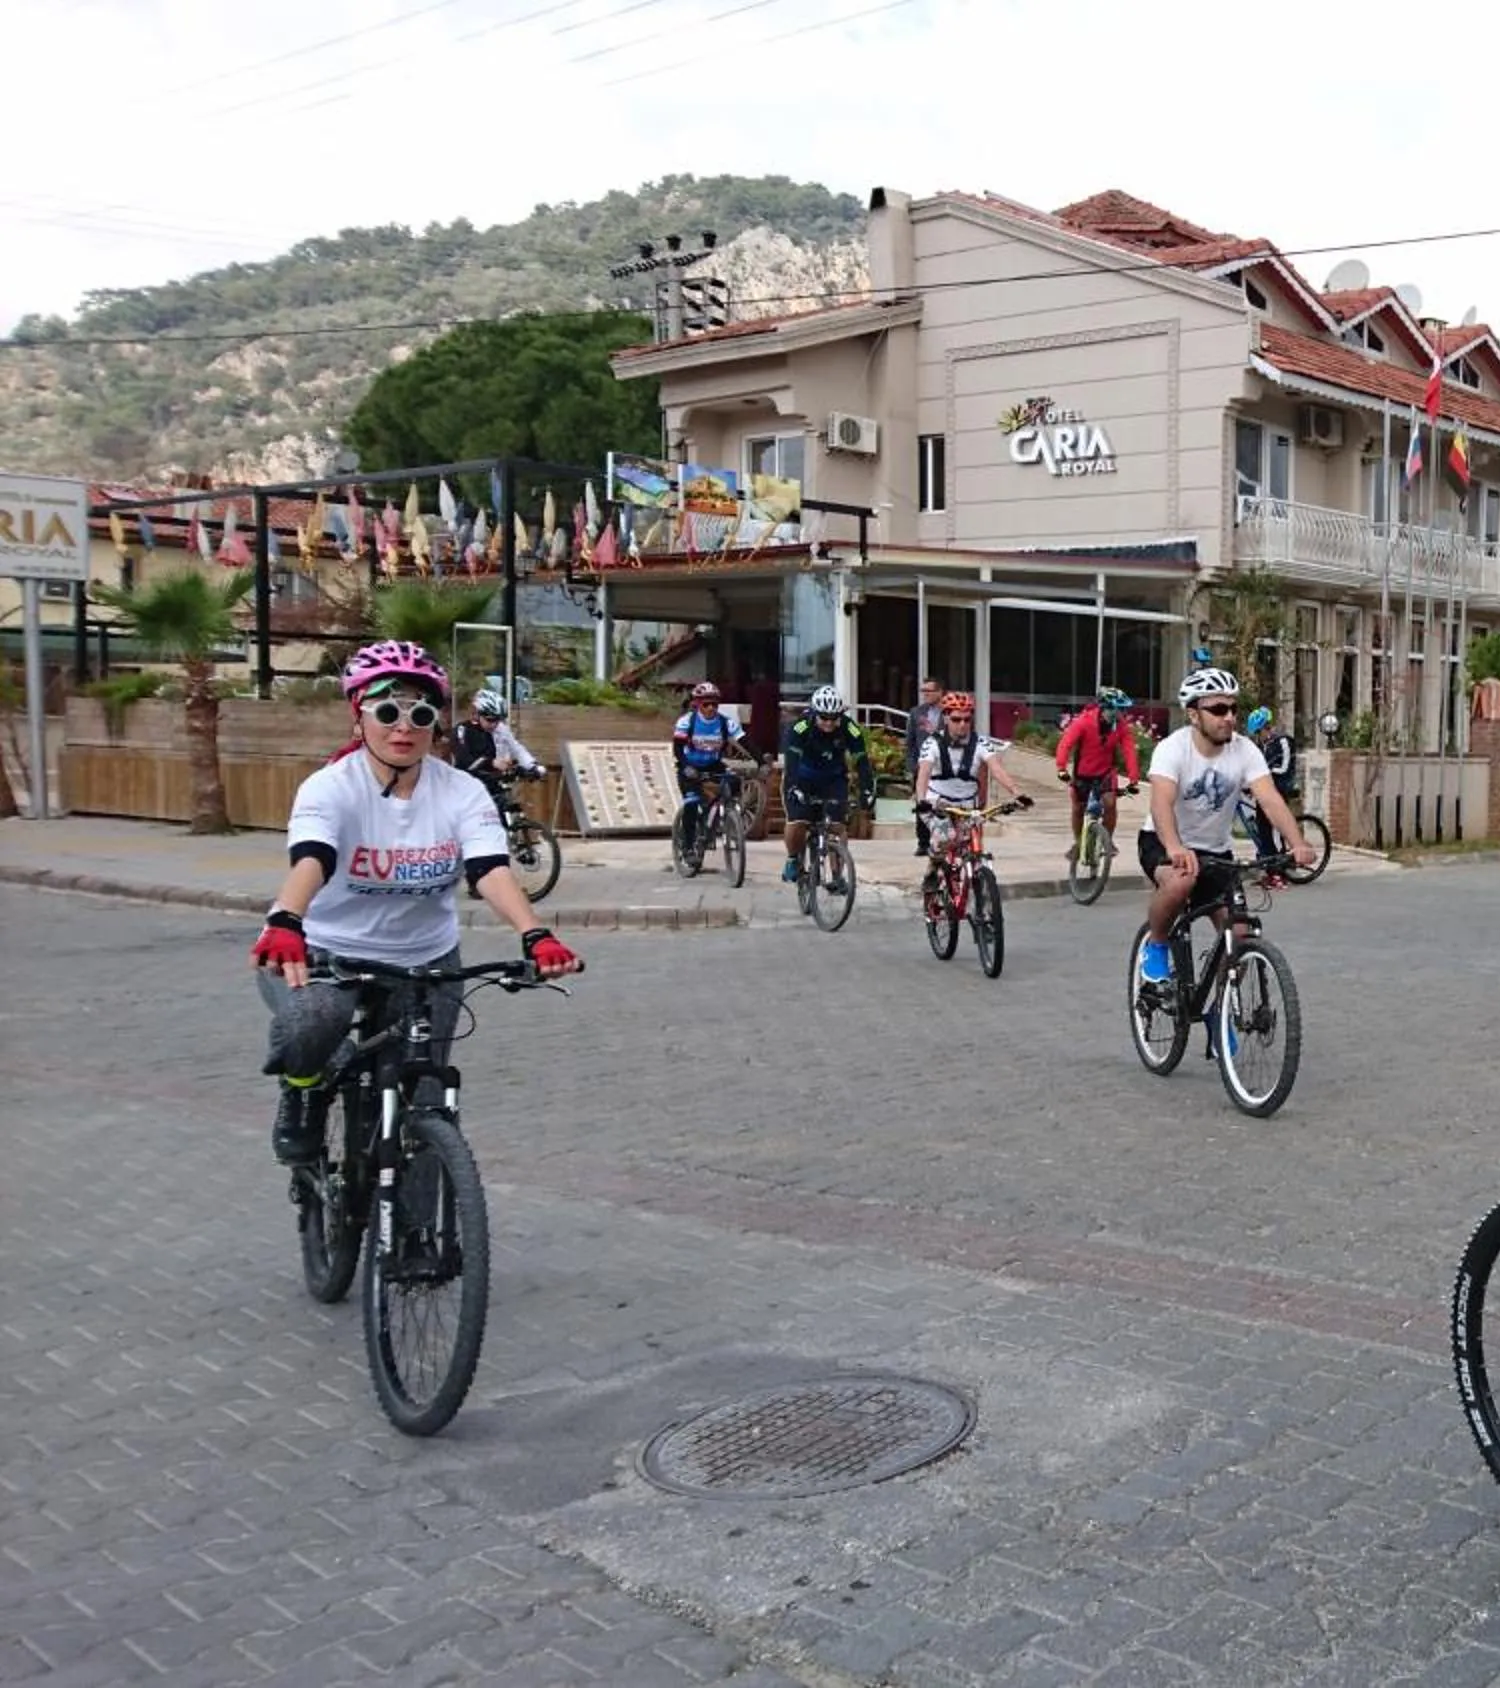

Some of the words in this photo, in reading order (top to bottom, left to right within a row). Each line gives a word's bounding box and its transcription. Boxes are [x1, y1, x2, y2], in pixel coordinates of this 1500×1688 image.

[1009, 424, 1112, 475] CARIA
[1060, 459, 1116, 476] ROYAL
[1456, 1271, 1472, 1351] ROCKET
